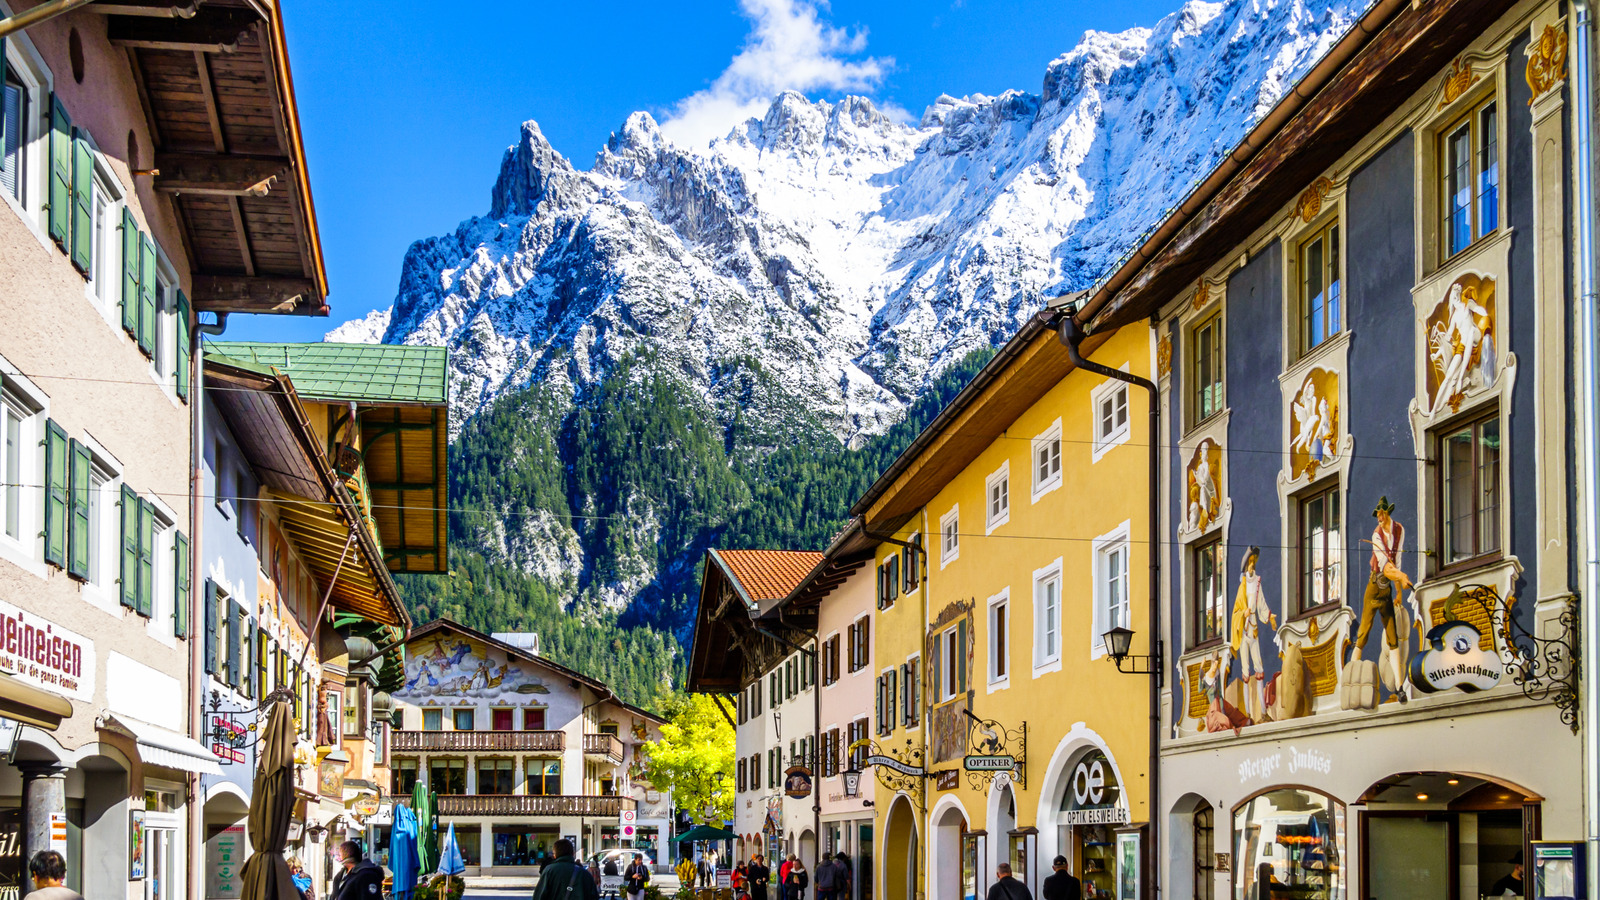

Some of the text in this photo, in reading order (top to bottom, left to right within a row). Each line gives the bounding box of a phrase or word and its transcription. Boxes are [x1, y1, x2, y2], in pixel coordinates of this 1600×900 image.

[0, 655, 13, 670] uhe
[1429, 663, 1499, 682] Altes Rathaus
[969, 758, 1010, 767] OPTIKER
[1238, 745, 1332, 784] Metzger Imbiss
[1067, 808, 1127, 824] OPTIK ELSWEILER
